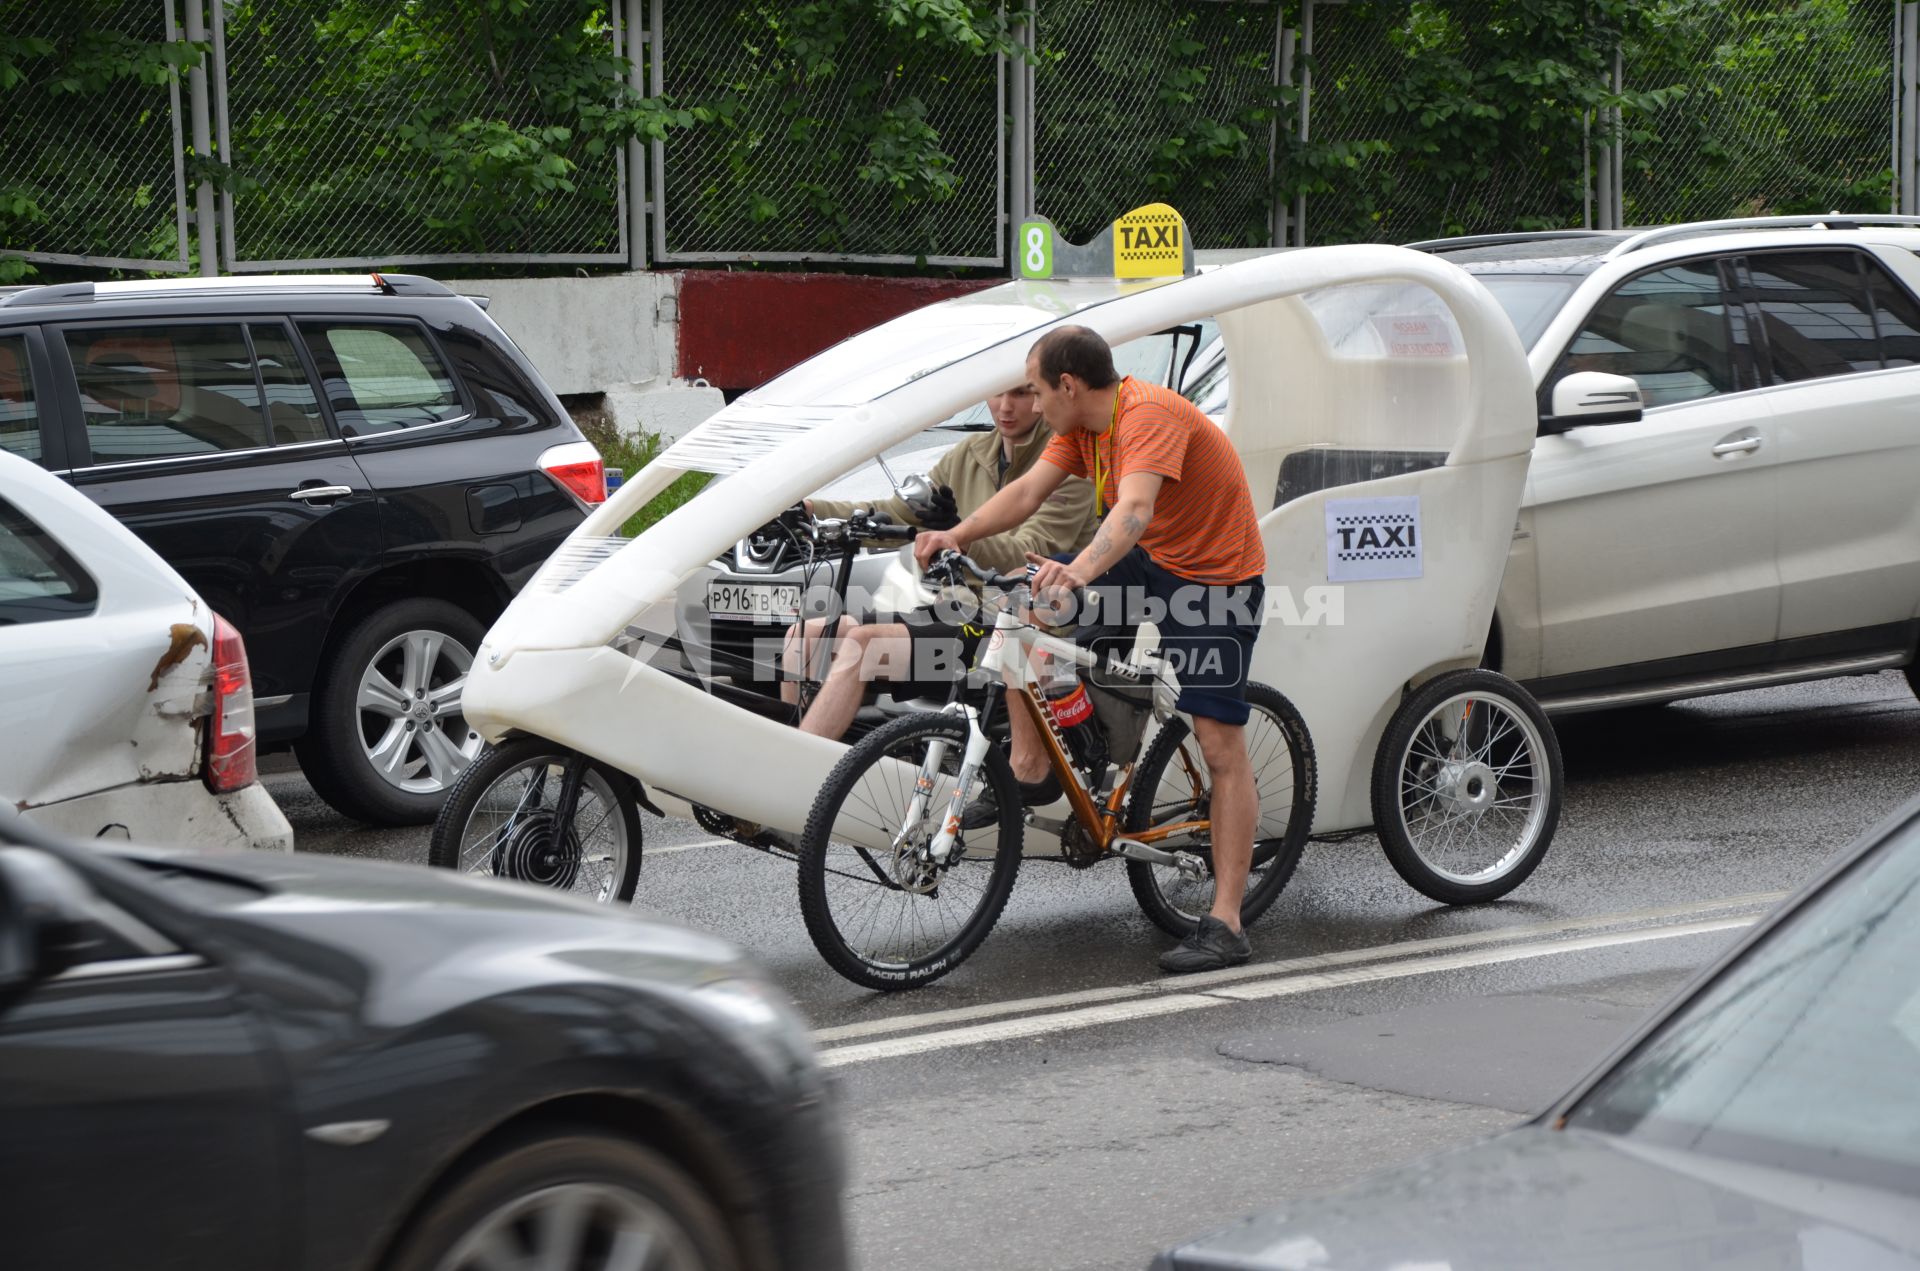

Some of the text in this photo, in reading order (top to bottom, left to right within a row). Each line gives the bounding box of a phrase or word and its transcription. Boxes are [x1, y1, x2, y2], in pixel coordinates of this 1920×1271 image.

[1120, 226, 1178, 249] TAXI
[1027, 228, 1045, 272] 8
[1337, 525, 1416, 549] TAXI
[773, 588, 795, 606] 197
[866, 958, 947, 981] RACING RALPH
